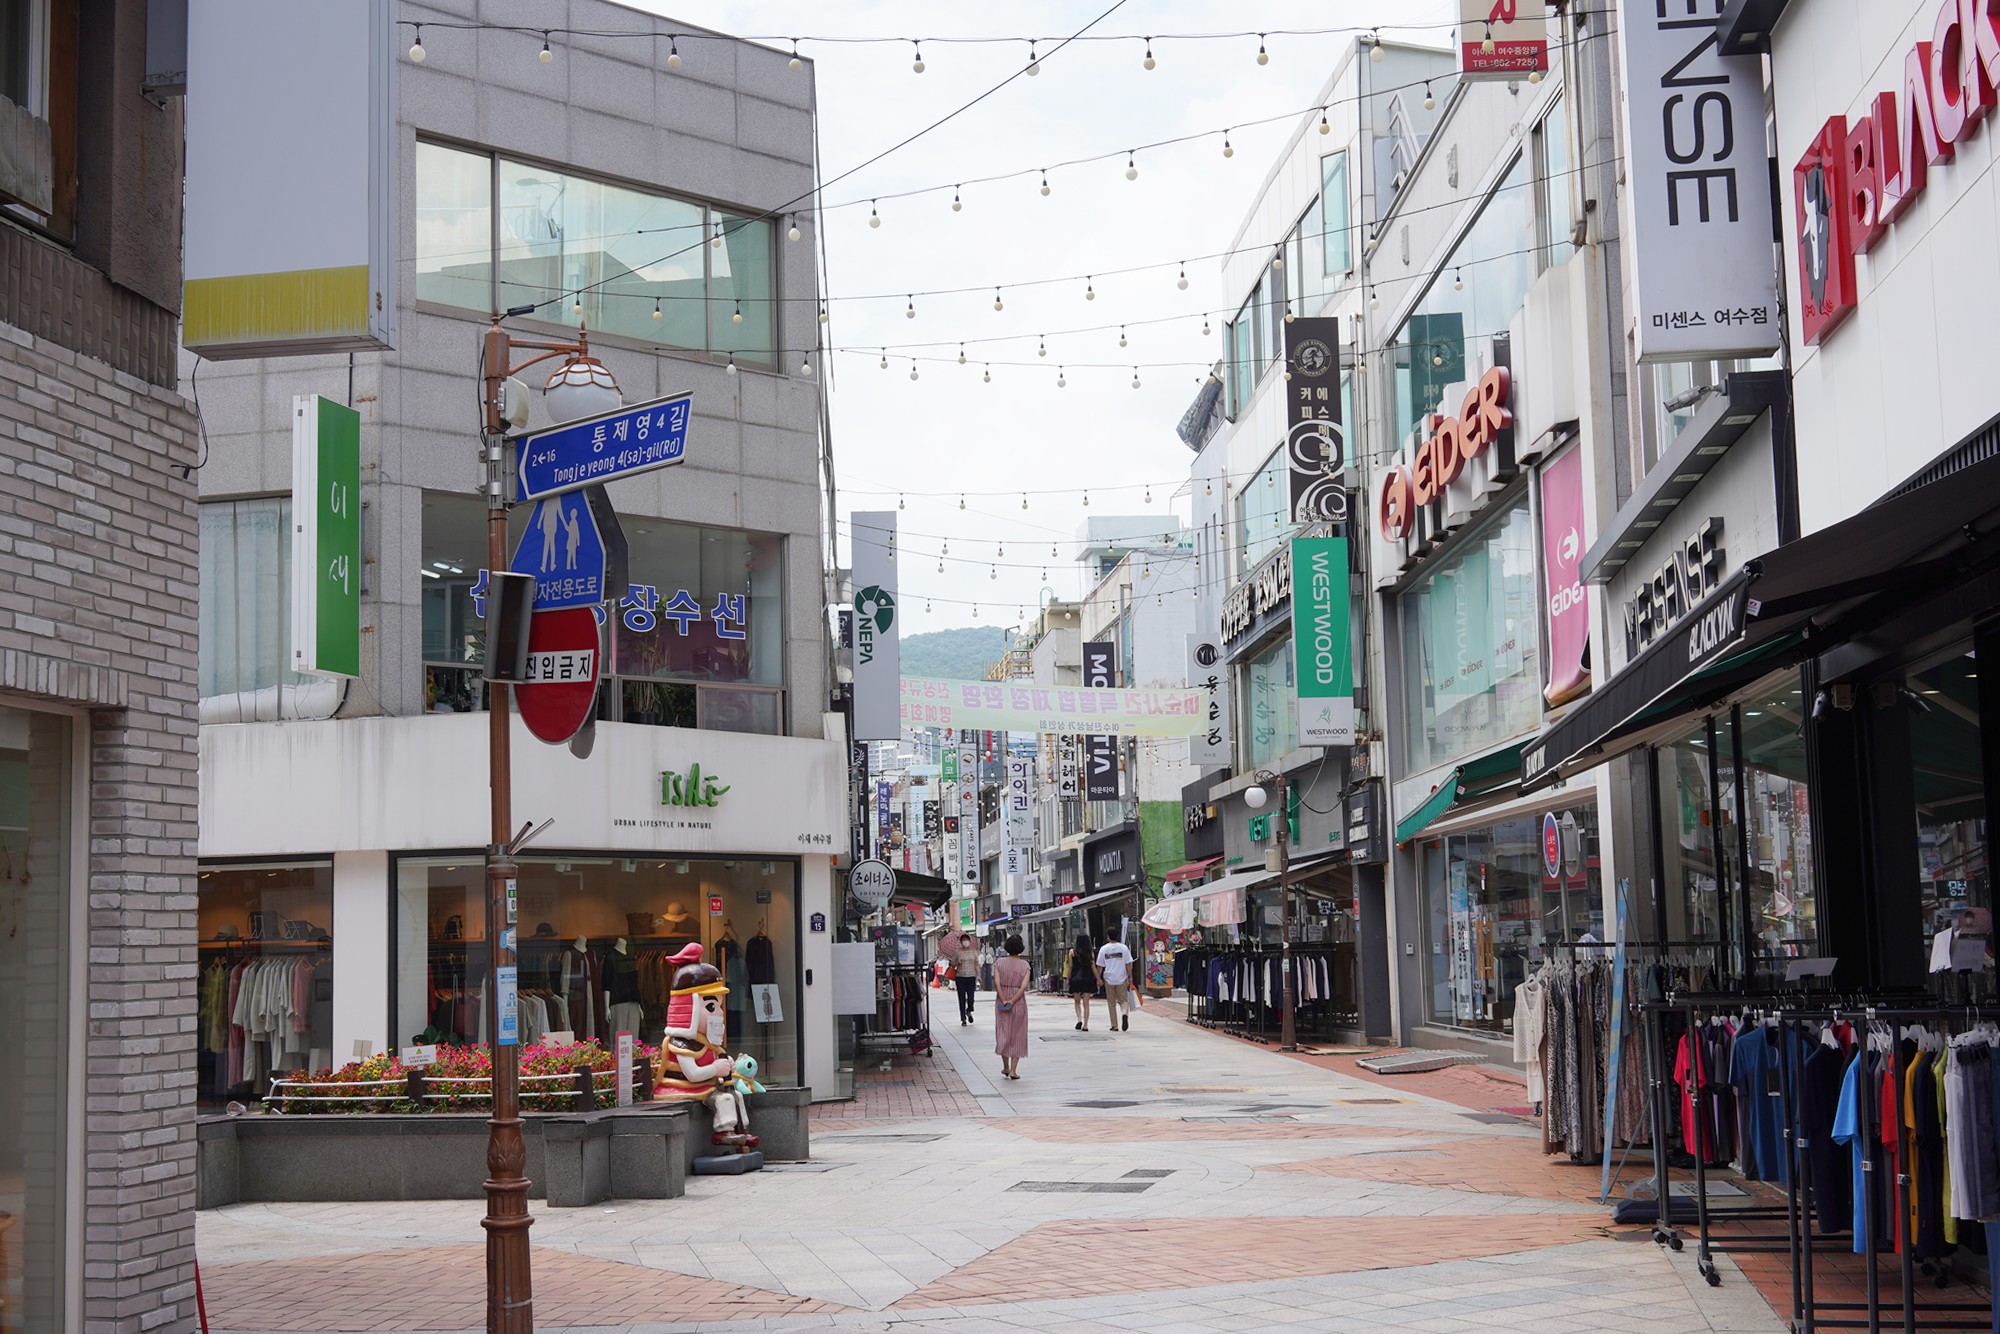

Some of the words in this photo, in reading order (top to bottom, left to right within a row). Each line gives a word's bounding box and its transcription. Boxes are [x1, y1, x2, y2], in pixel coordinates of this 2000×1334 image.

[1652, 311, 1707, 330] 미센스
[1714, 306, 1768, 326] 여수점
[1300, 387, 1313, 420] 커피
[617, 437, 681, 468] 4(sa)-gil(Rd)
[1311, 550, 1334, 685] WESTWOOD
[858, 617, 874, 666] NEPA
[525, 653, 592, 681] 진입금지
[1091, 654, 1111, 775] MOTIA
[1306, 727, 1349, 736] WESTWOOD
[1090, 786, 1116, 795] 마운티아
[613, 819, 637, 827] URBAN
[639, 820, 674, 829] LIFESTYLE
[677, 821, 685, 829] IN
[687, 822, 712, 830] NATURE
[854, 871, 891, 887] 조이너스
[814, 922, 822, 932] 15
